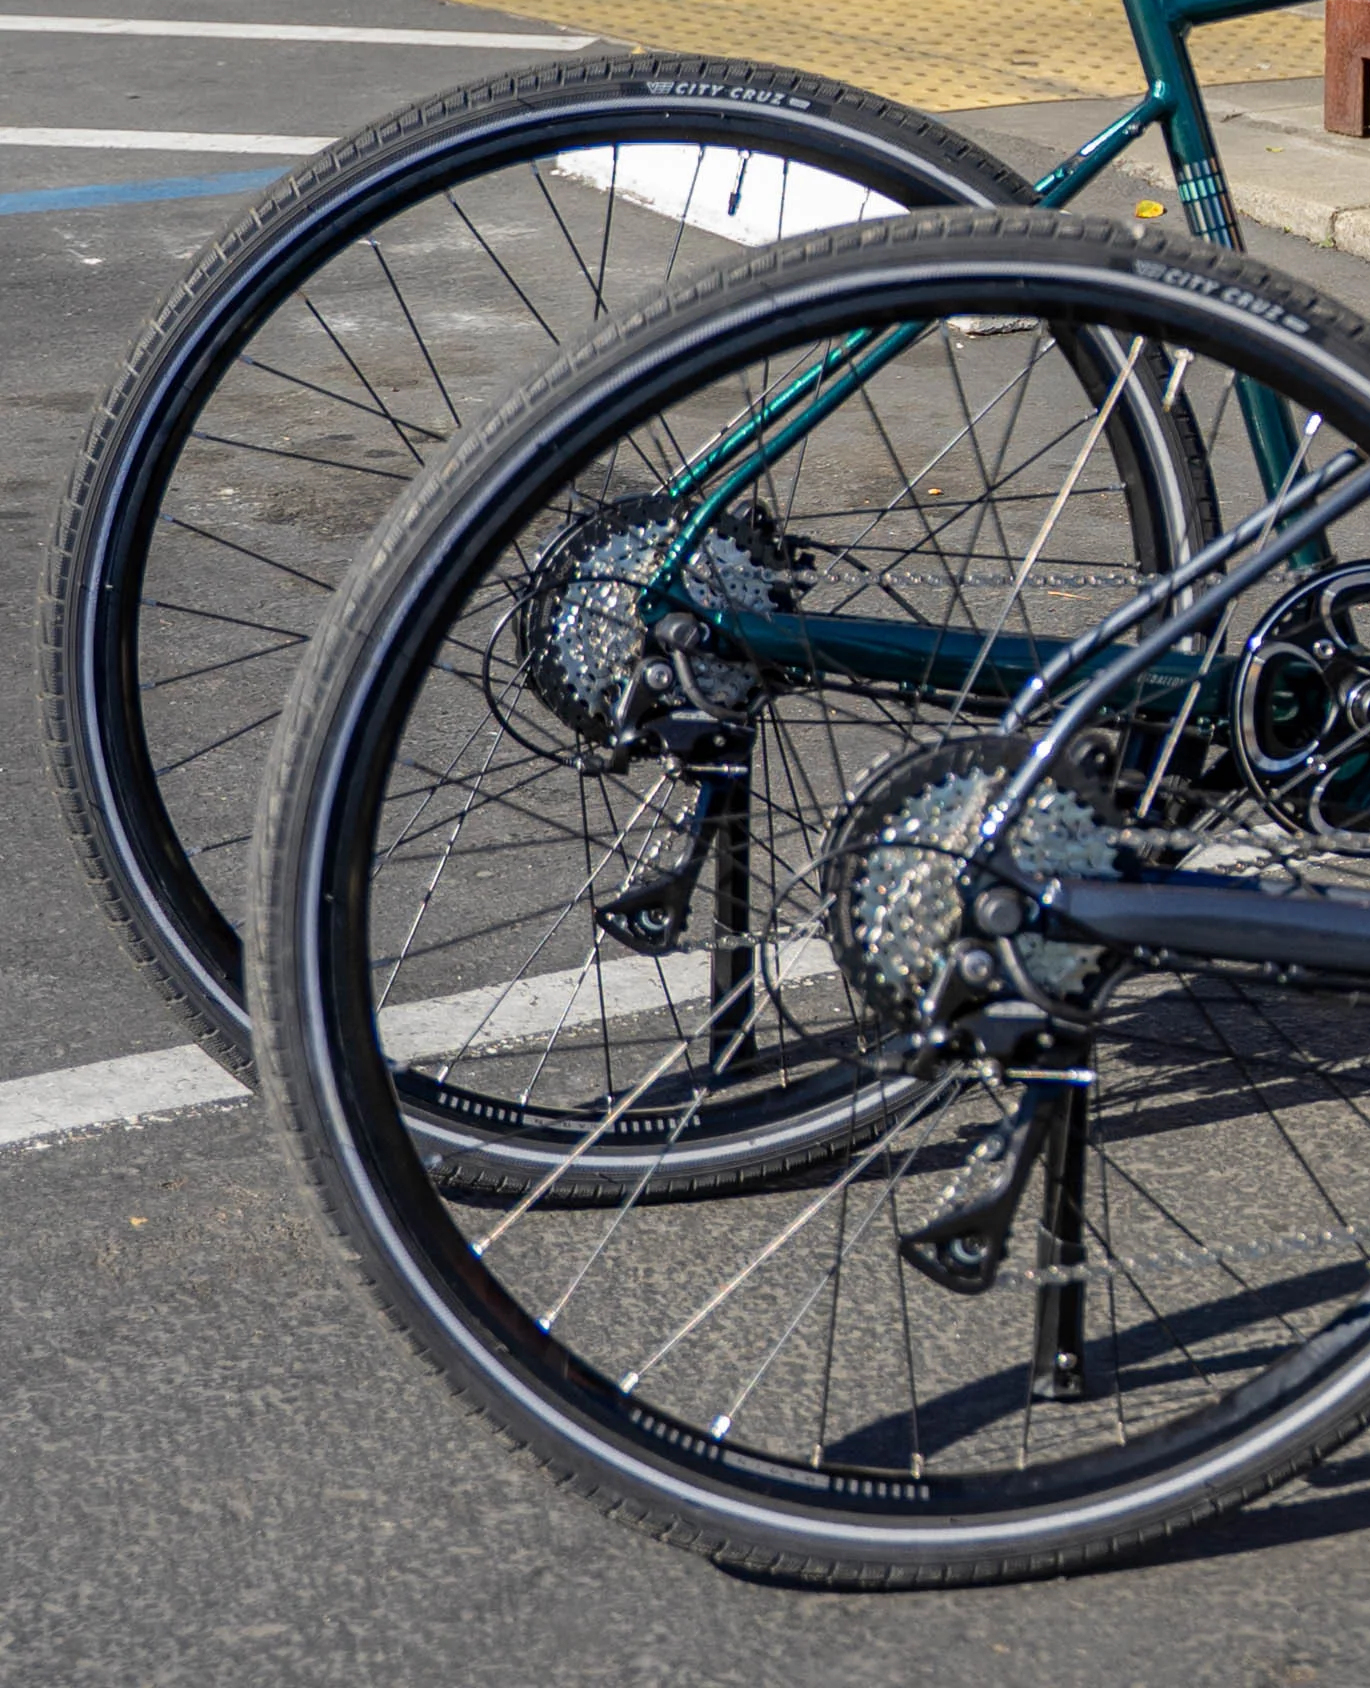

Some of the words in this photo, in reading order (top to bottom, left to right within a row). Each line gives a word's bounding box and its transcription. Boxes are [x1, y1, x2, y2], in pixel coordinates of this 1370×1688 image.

[675, 81, 724, 97] CITY
[729, 86, 786, 105] CRUZ
[1163, 267, 1220, 295] CITY
[1220, 286, 1286, 321] CRUZ
